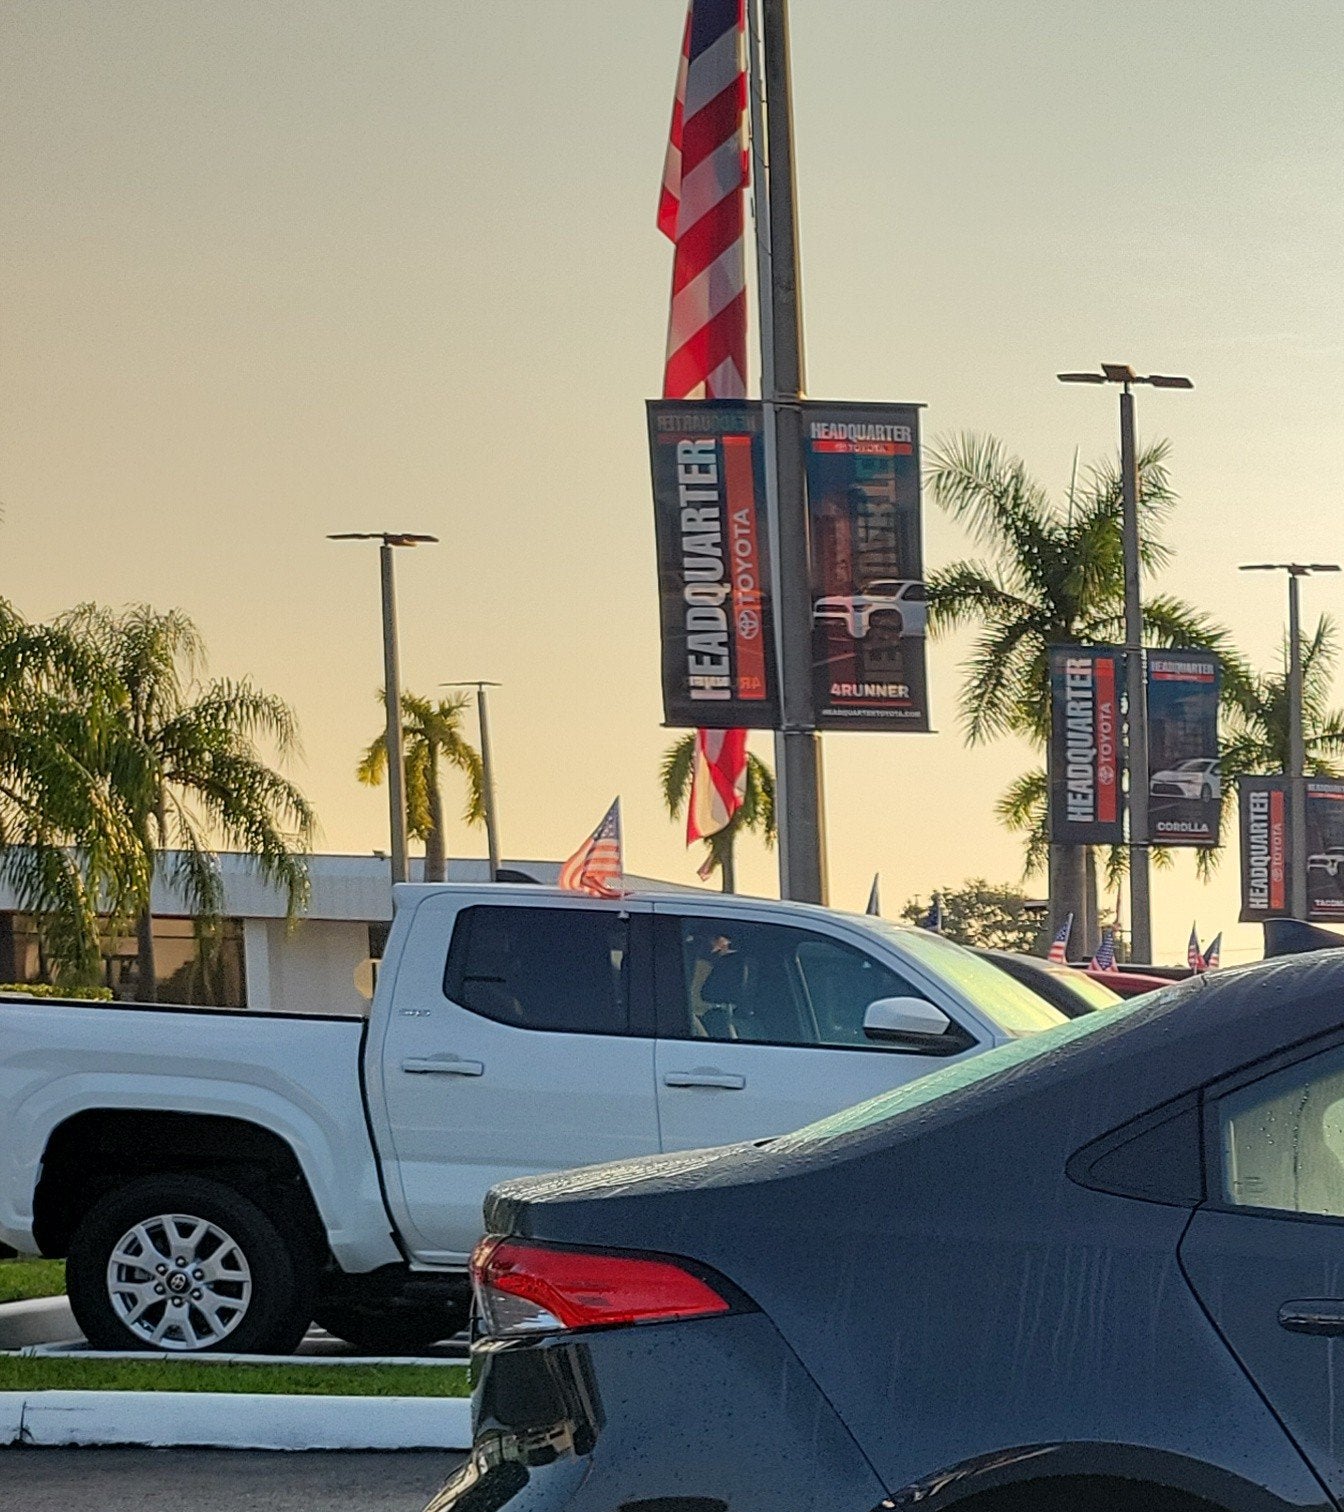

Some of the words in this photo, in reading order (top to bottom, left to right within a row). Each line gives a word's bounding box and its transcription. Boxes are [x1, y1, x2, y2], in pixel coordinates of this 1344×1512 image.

[811, 422, 911, 442] HEADQUARTER
[677, 438, 731, 700] HEADQUARTER
[733, 508, 756, 605] TOYOTA
[830, 683, 910, 698] 4RUNNER
[1066, 658, 1097, 822] HEADQUARTER
[1101, 702, 1112, 763] TOYOTA
[1158, 822, 1209, 832] COROLLA
[1249, 792, 1271, 909] HEADQUARTER
